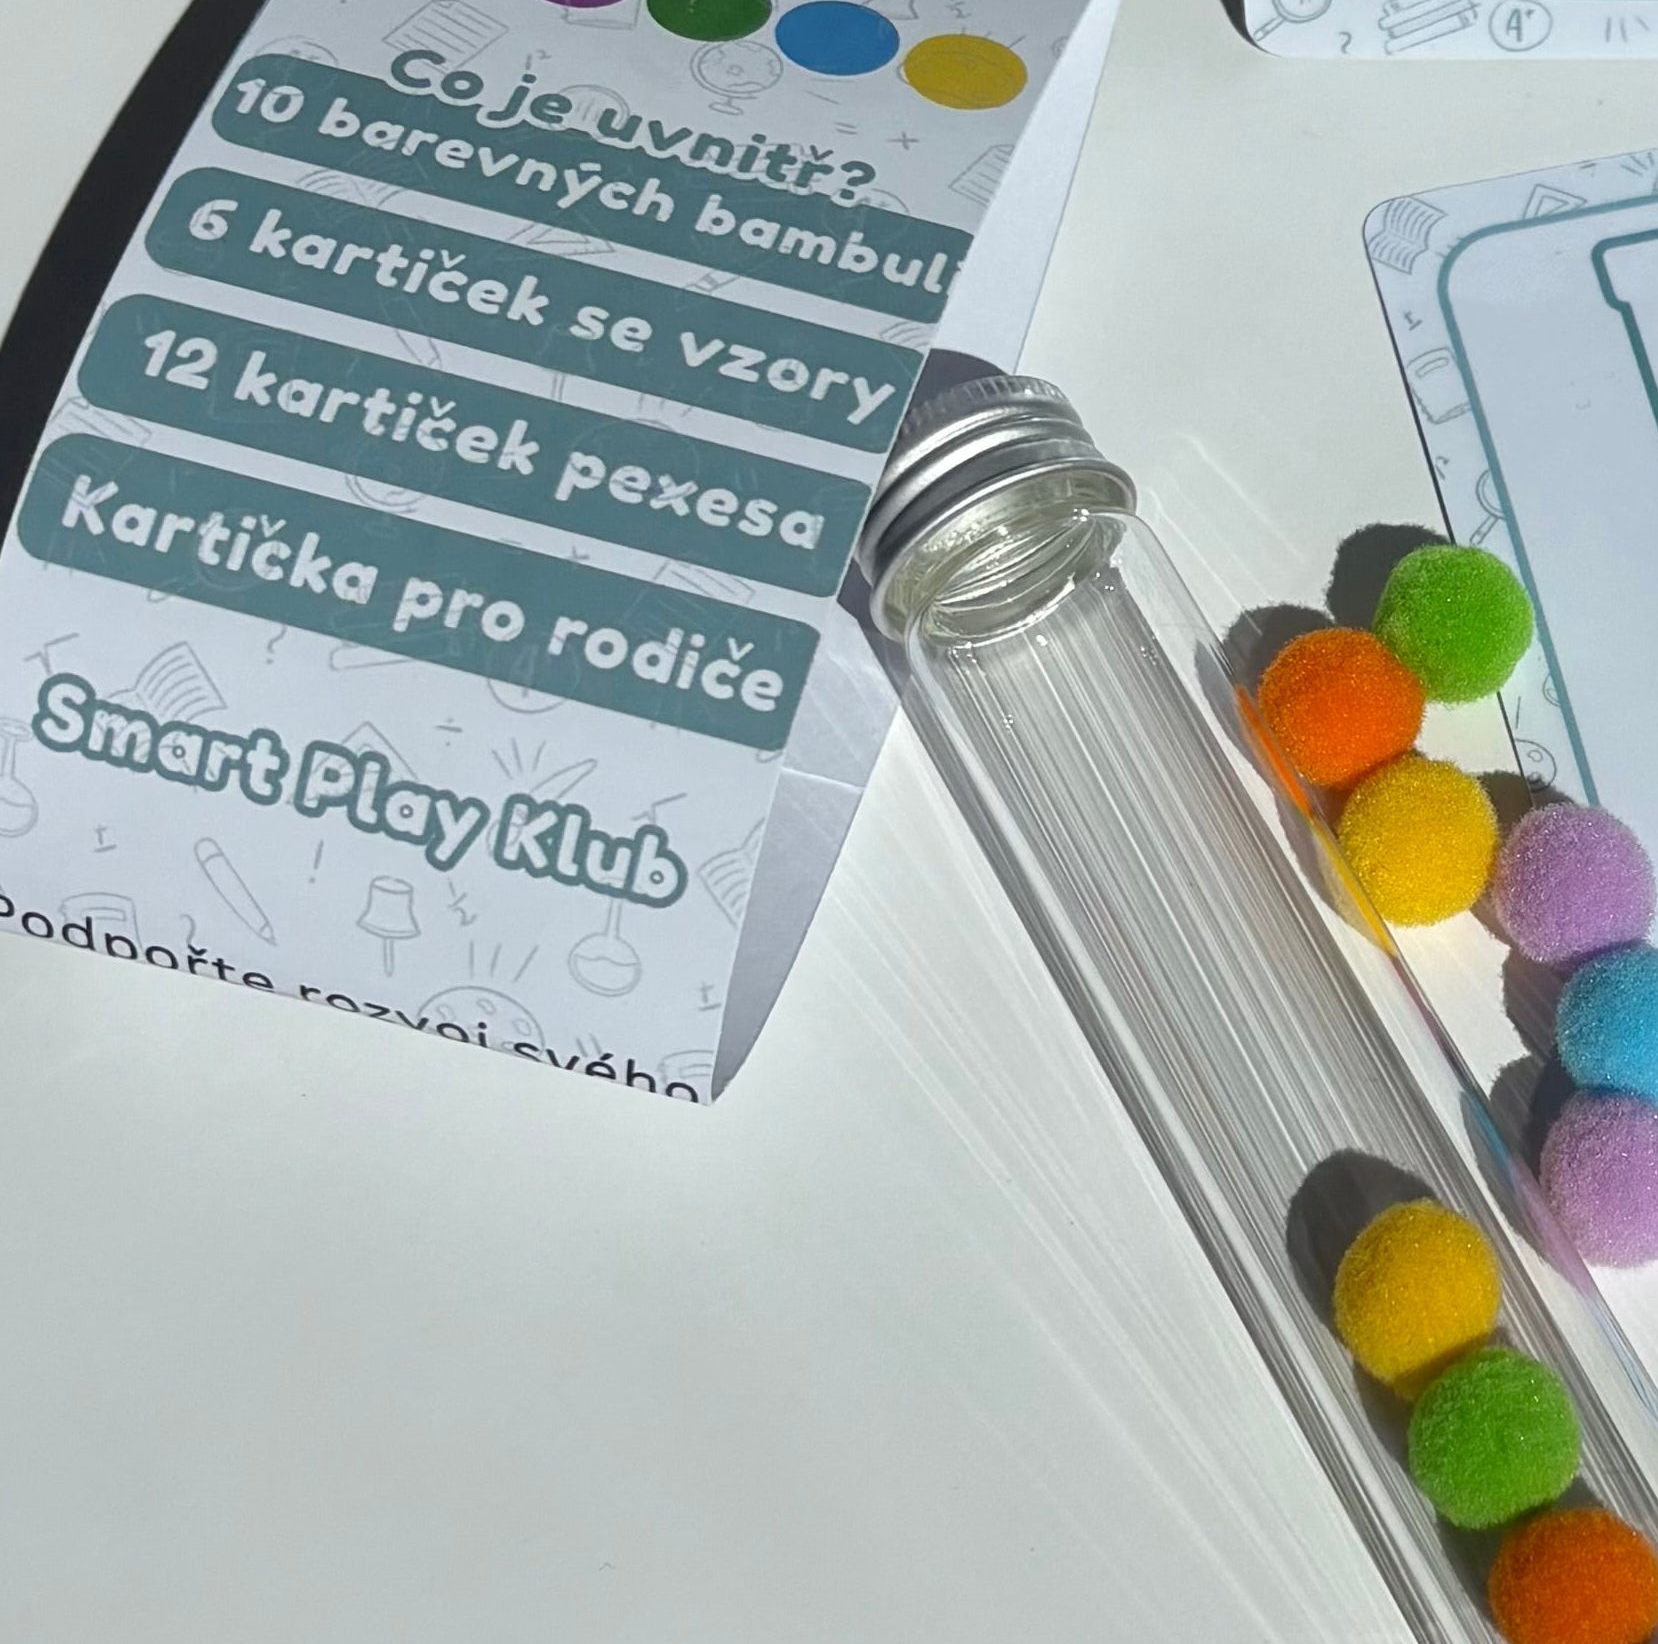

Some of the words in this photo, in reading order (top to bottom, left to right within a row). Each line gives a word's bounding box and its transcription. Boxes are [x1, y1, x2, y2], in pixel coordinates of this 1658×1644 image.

[232, 78, 307, 125] 10
[319, 92, 676, 227] barevných
[695, 194, 966, 294] bambul
[388, 47, 481, 110] Co
[476, 71, 575, 132] je
[595, 101, 879, 209] uvnitř?
[187, 199, 239, 241] 6
[250, 209, 550, 328] kartiček
[568, 296, 654, 353] se
[678, 330, 898, 425] vzory
[142, 330, 220, 391] 12
[234, 357, 541, 481] kartiček
[555, 449, 825, 553] pexesa
[61, 474, 379, 605] Kartička
[392, 577, 525, 644] pro
[547, 612, 783, 713] rodiče
[33, 672, 289, 805] Smart
[293, 740, 492, 871] Play
[494, 793, 688, 909] Klub
